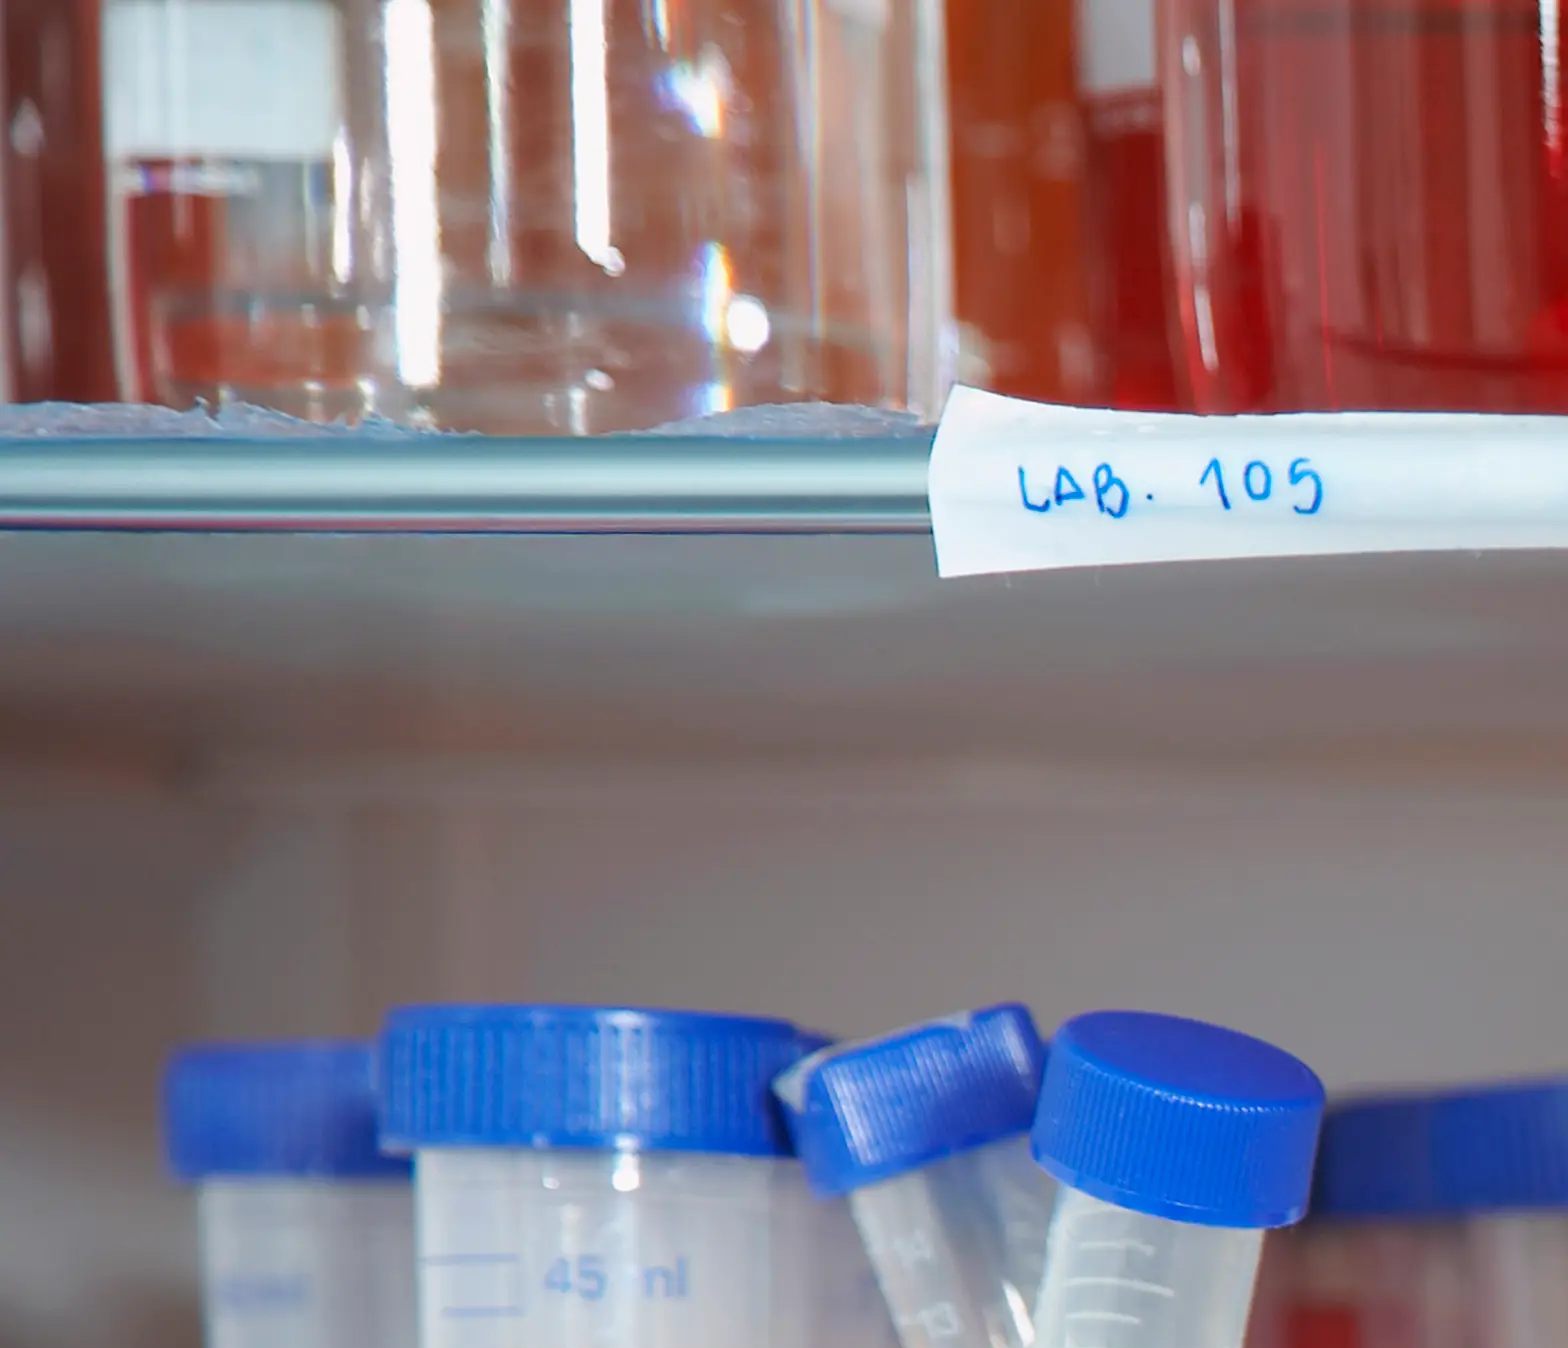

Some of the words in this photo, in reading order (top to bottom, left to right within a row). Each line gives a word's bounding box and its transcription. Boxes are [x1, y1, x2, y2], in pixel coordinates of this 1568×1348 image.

[1017, 461, 1153, 519] LAB.
[1199, 457, 1323, 515] 105
[542, 1254, 609, 1302] 45
